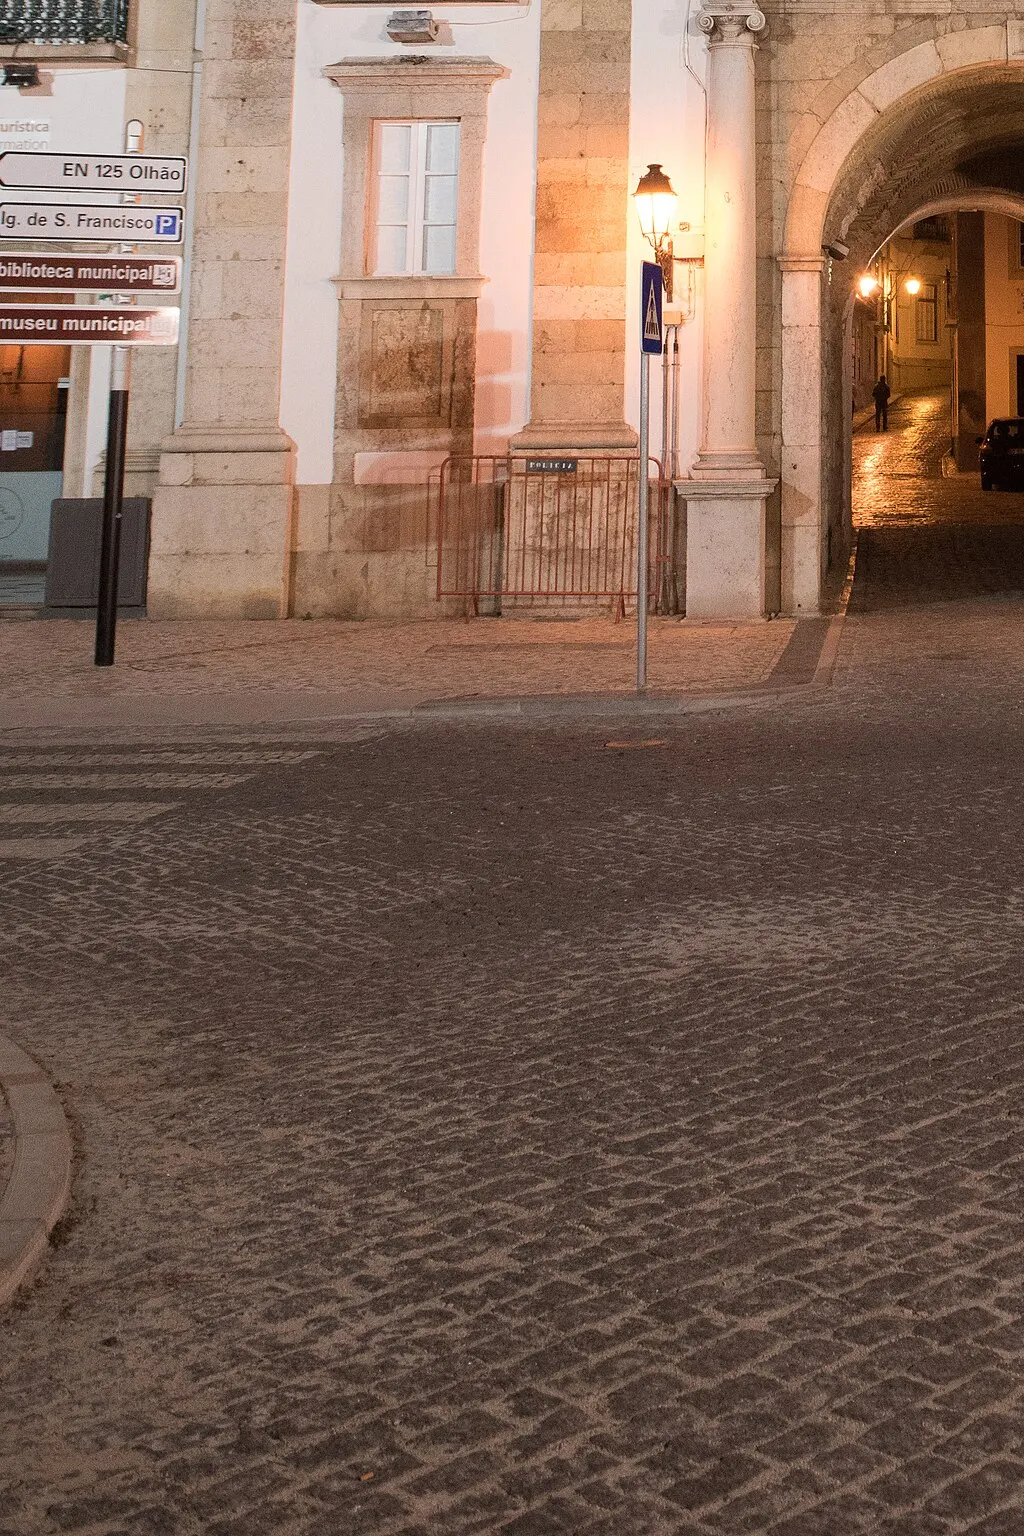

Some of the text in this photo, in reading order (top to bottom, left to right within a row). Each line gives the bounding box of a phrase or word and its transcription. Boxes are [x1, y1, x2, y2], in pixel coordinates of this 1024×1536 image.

[63, 163, 180, 180] EN 125 Olhão
[27, 213, 47, 226] de
[54, 213, 70, 227] S.
[77, 214, 153, 229] Francisco
[0, 262, 153, 283] biblioteca municipal
[0, 316, 150, 335] museu municipal
